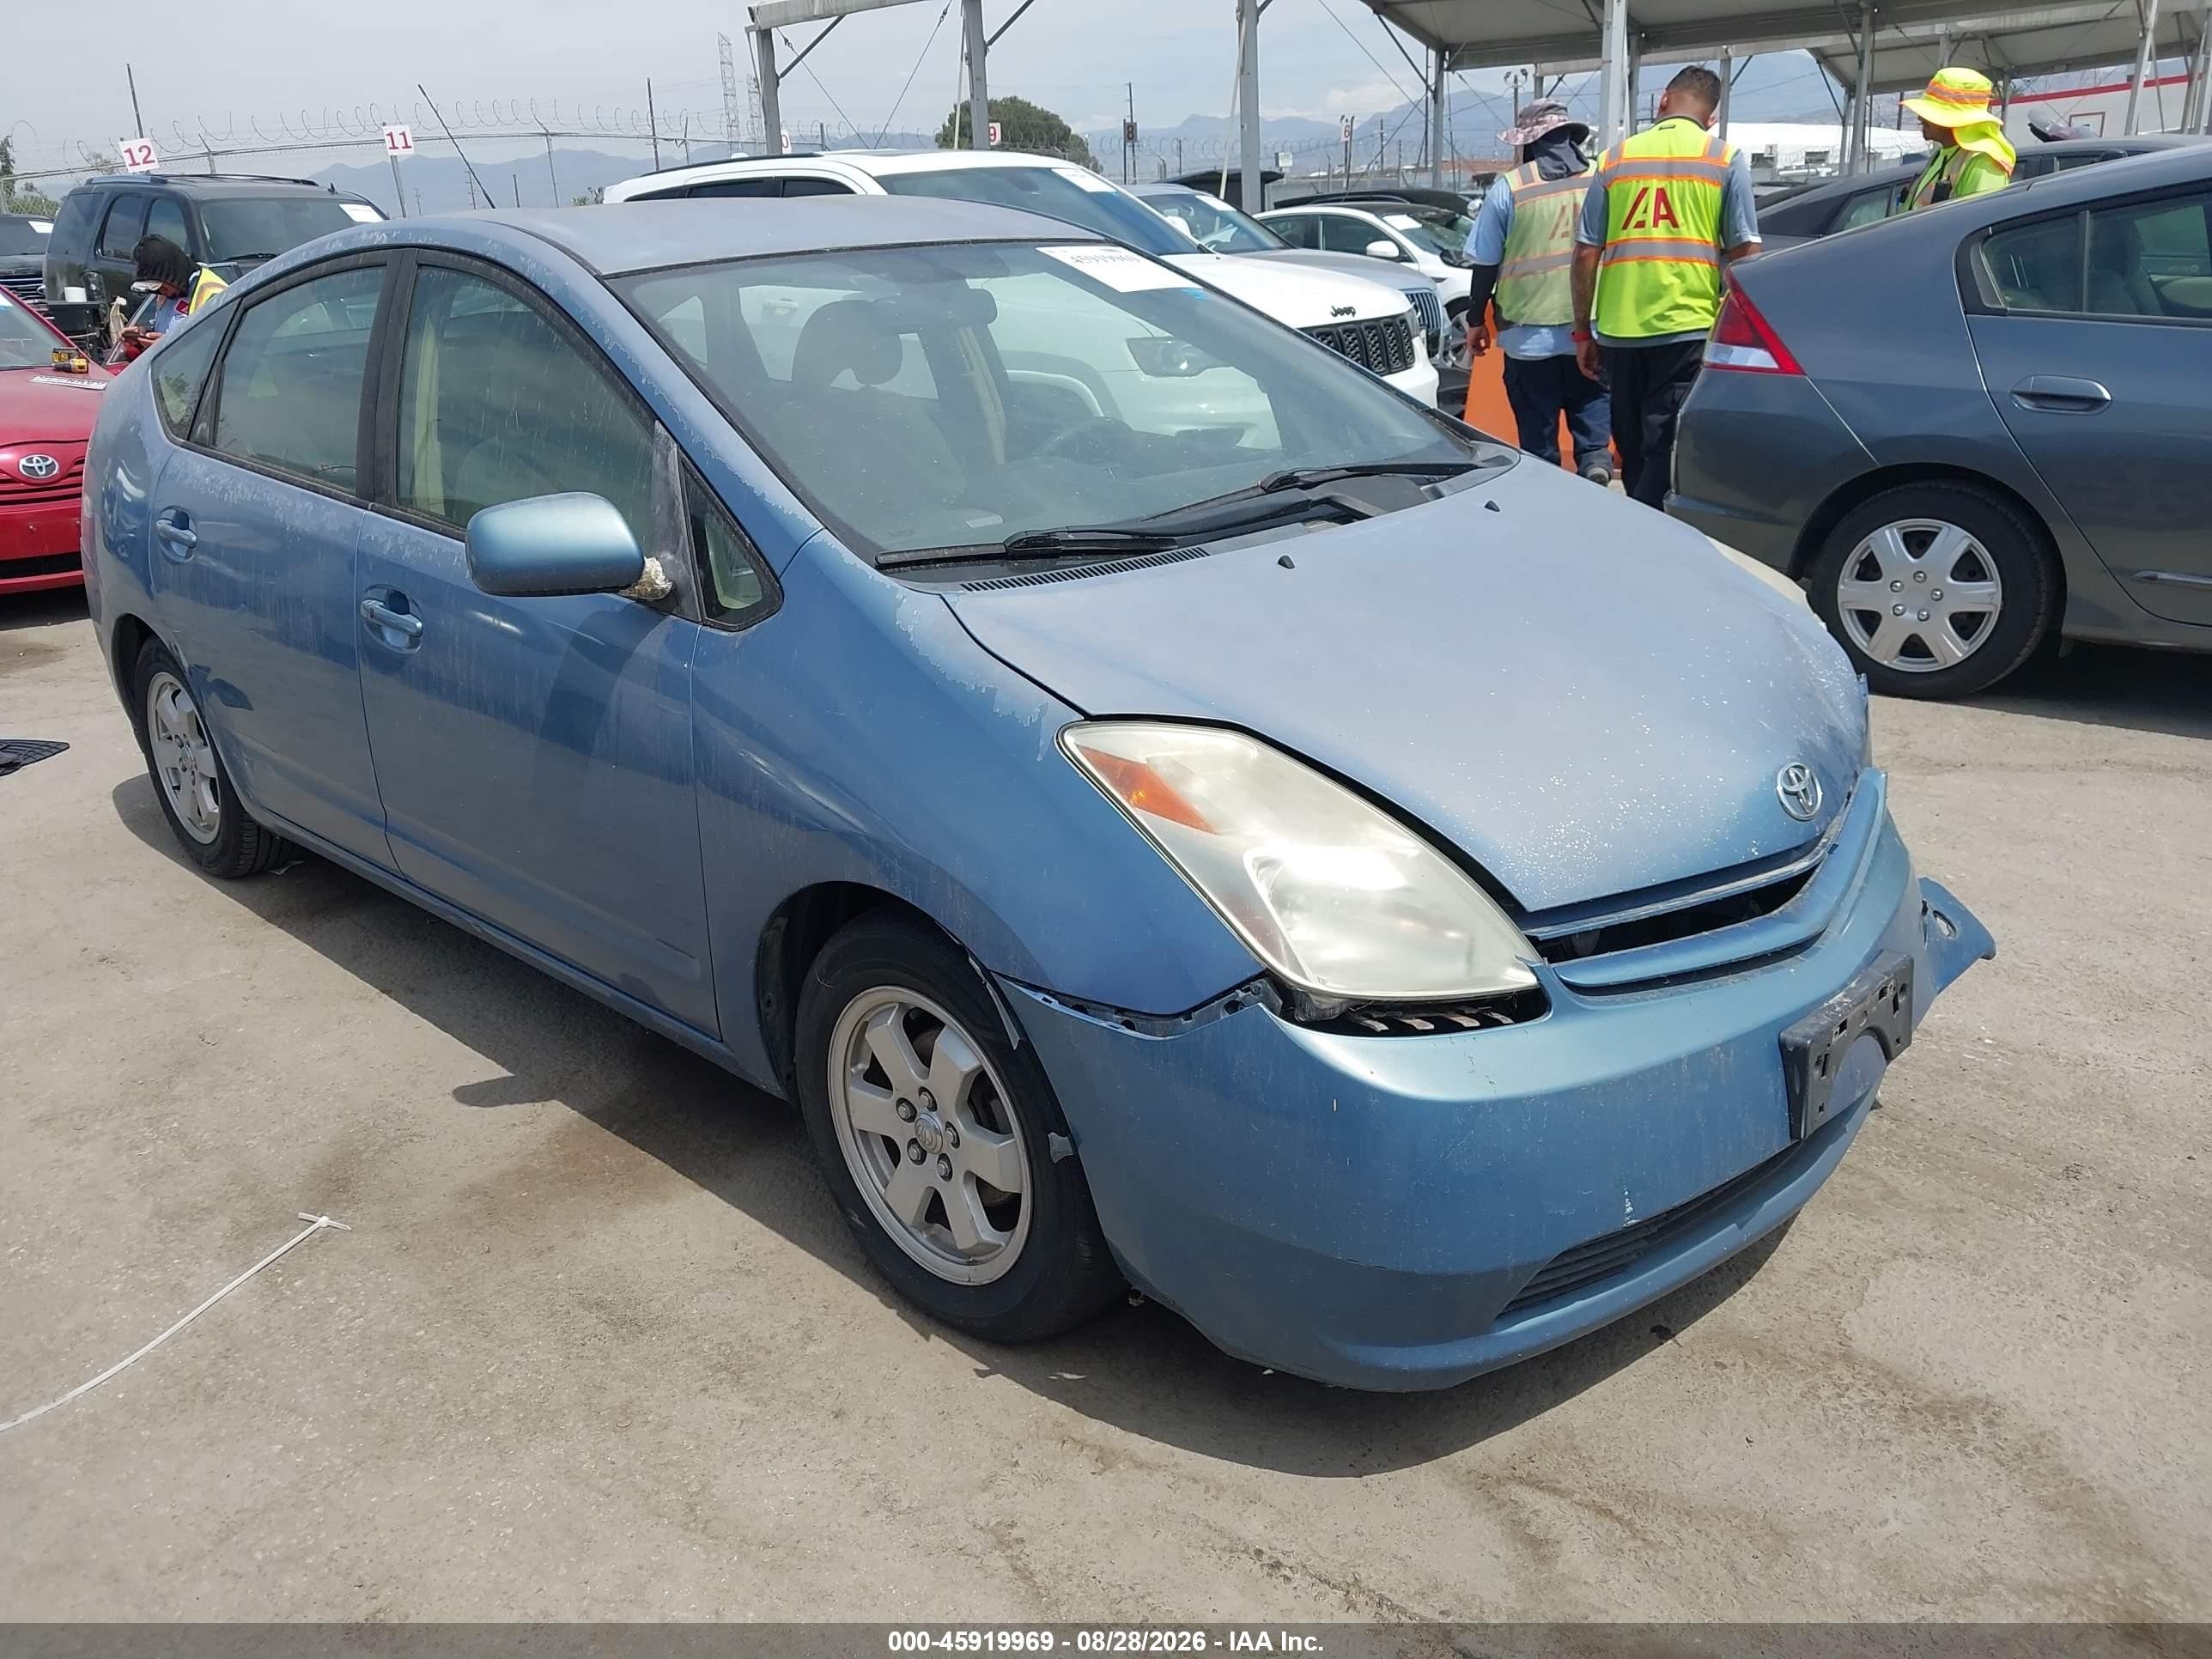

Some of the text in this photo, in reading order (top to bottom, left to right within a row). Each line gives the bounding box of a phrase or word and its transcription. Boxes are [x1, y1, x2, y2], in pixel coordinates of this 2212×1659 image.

[989, 125, 997, 143] 9
[1127, 125, 1134, 141] 8
[1344, 125, 1351, 138] 6
[386, 131, 412, 150] 11
[124, 144, 155, 167] 12
[1330, 305, 1357, 318] Jeep
